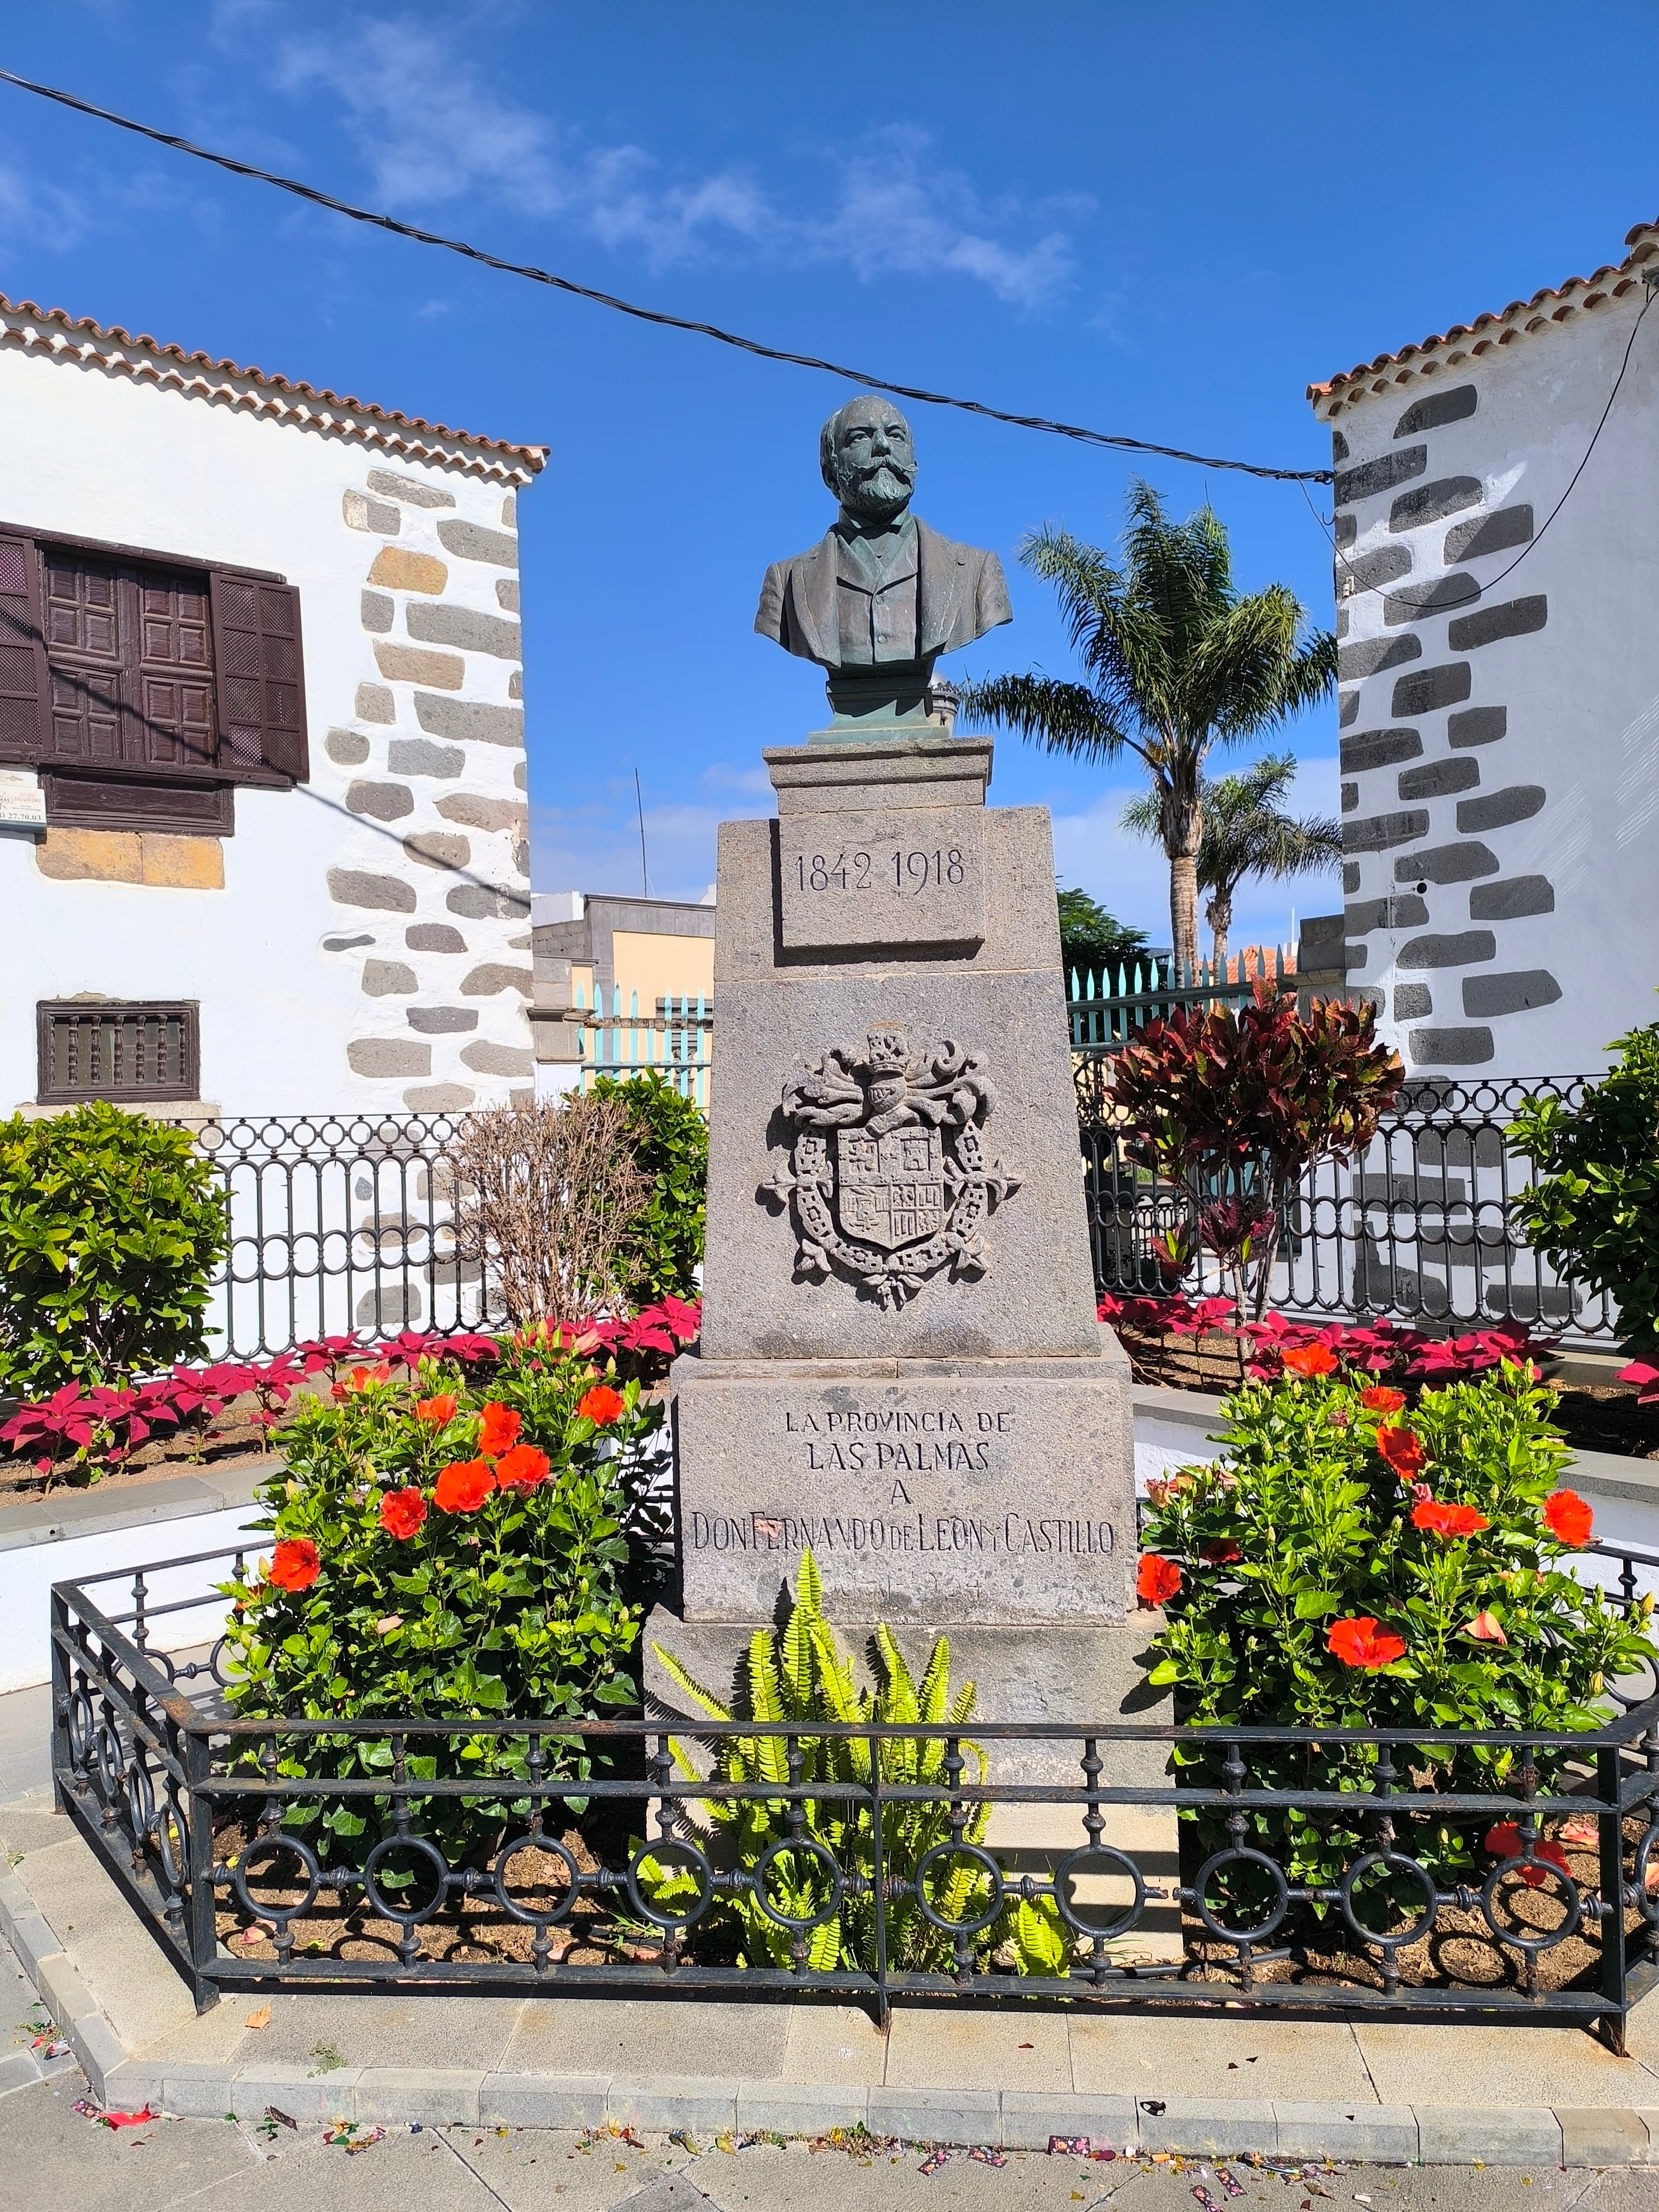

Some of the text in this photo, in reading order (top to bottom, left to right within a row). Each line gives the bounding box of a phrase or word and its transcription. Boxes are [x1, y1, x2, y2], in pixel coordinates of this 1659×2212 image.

[794, 849, 964, 896] 1842 1918
[786, 1412, 1010, 1433] LA PROVINCIA DE
[806, 1442, 990, 1471] LAS PALMAS
[891, 1479, 912, 1505] A
[691, 1511, 747, 1551] DON
[749, 1511, 885, 1551] FERNANDO
[890, 1525, 914, 1552] DE
[1005, 1512, 1115, 1554] CASTILLO
